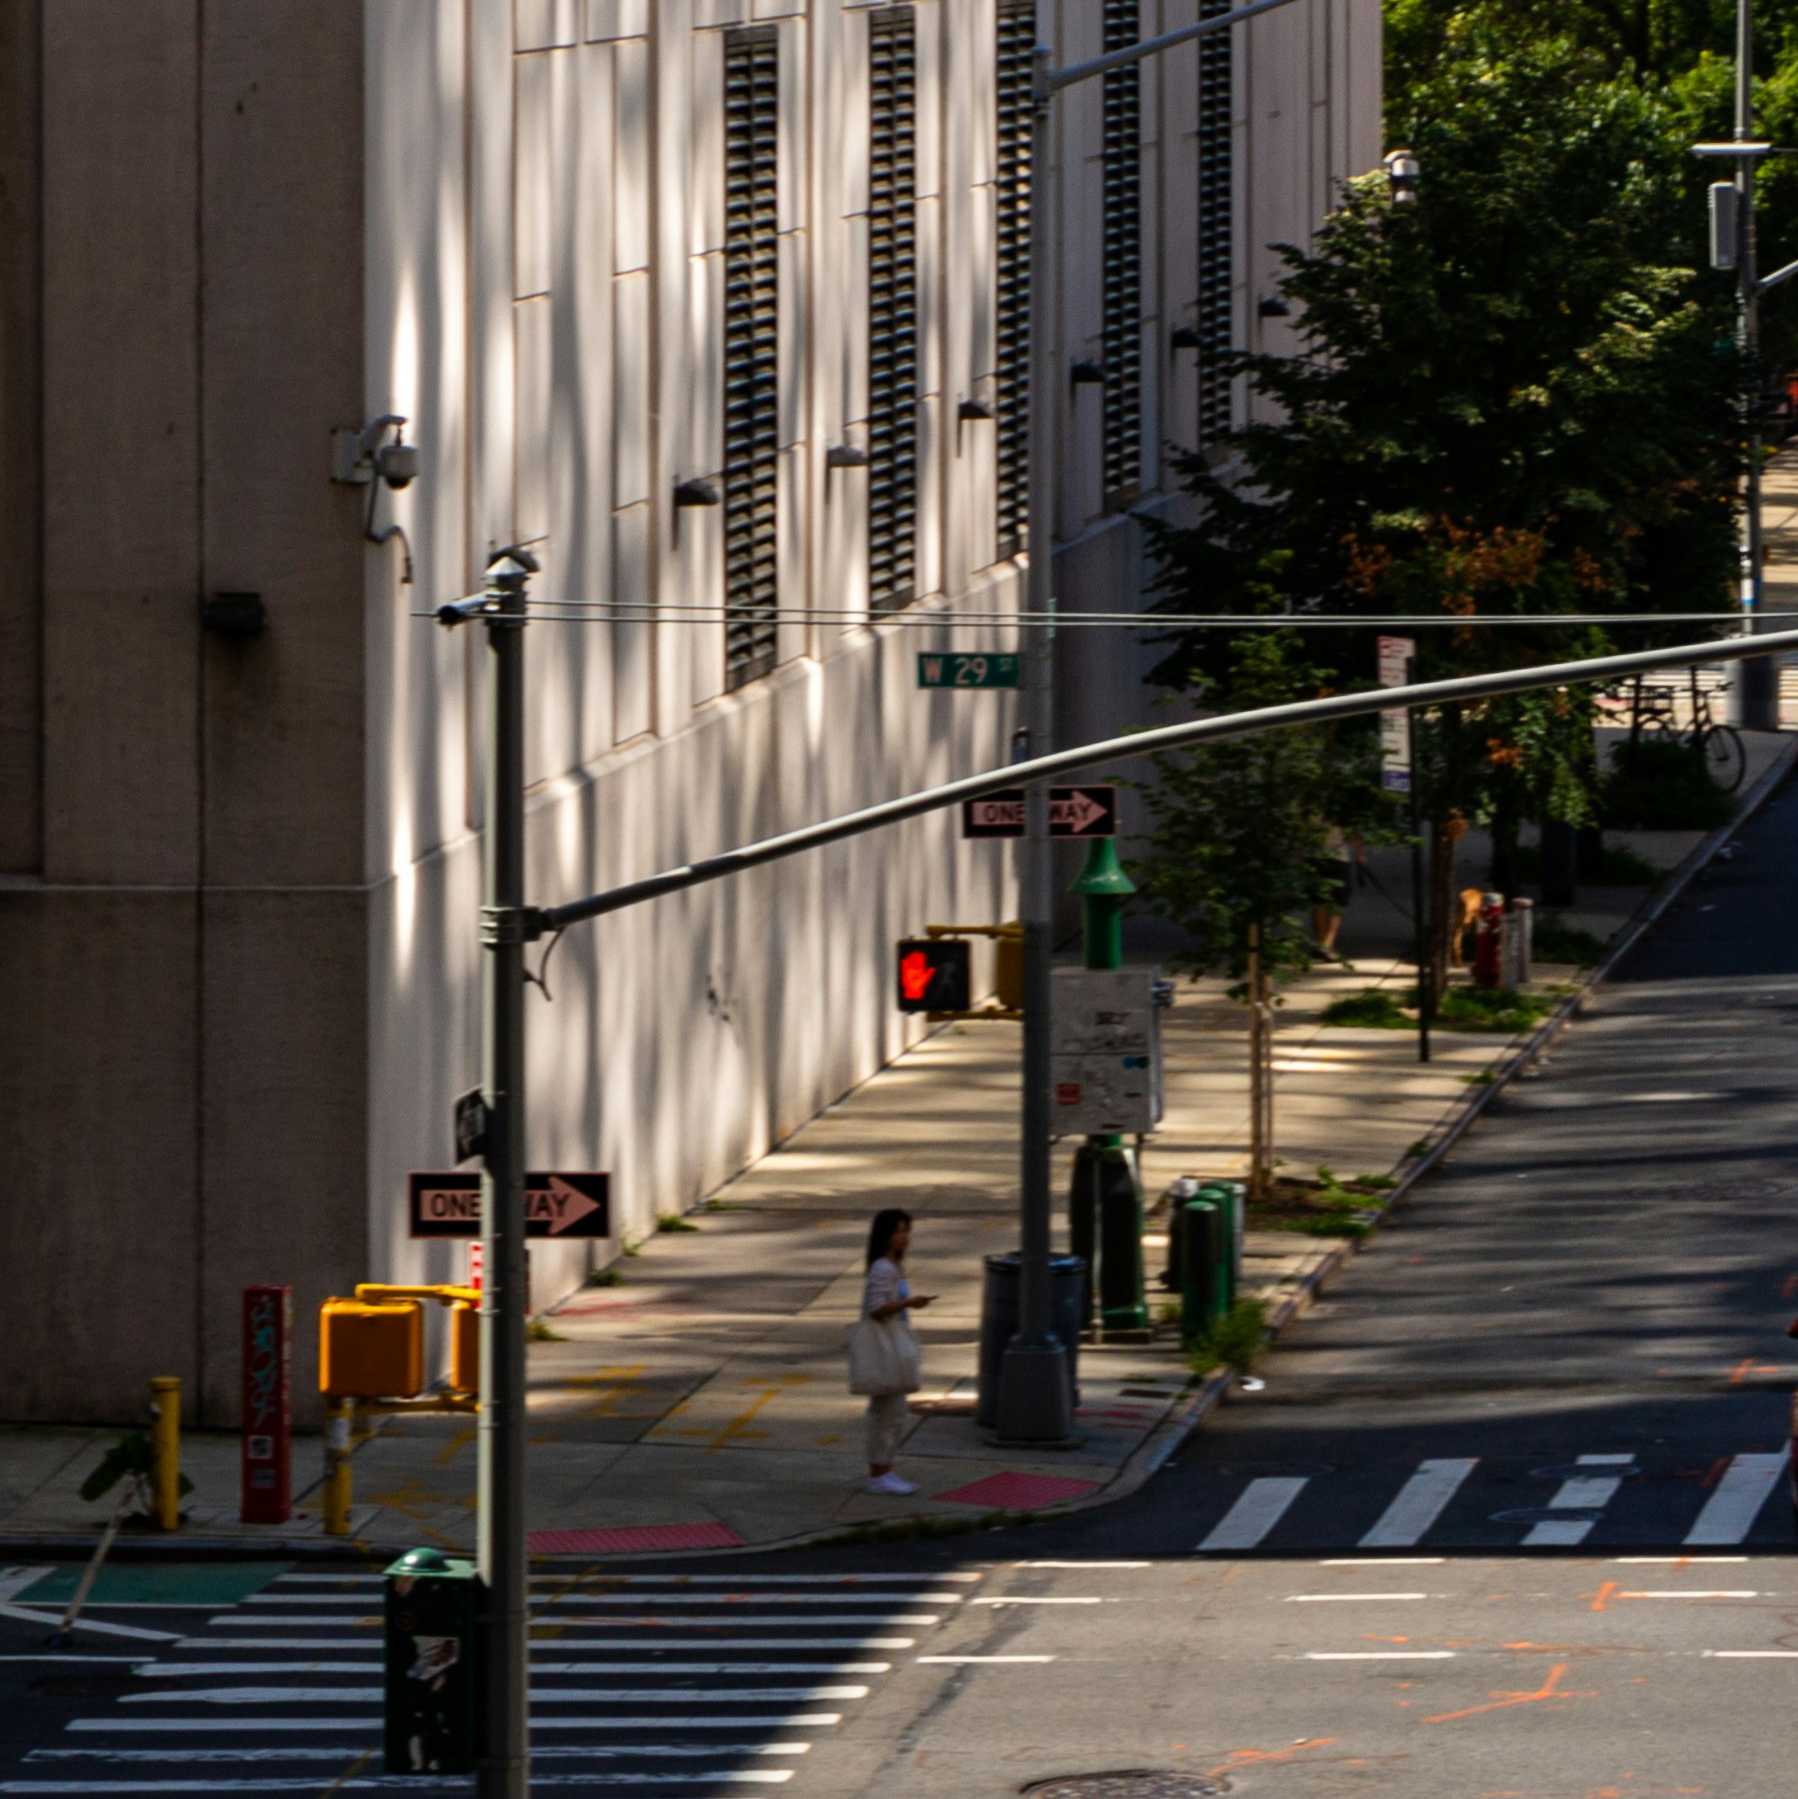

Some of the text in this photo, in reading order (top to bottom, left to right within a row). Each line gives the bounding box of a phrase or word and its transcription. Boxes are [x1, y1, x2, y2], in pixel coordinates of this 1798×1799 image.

[922, 657, 943, 683] W
[955, 656, 988, 684] 29
[431, 1193, 570, 1218] ONE AY
